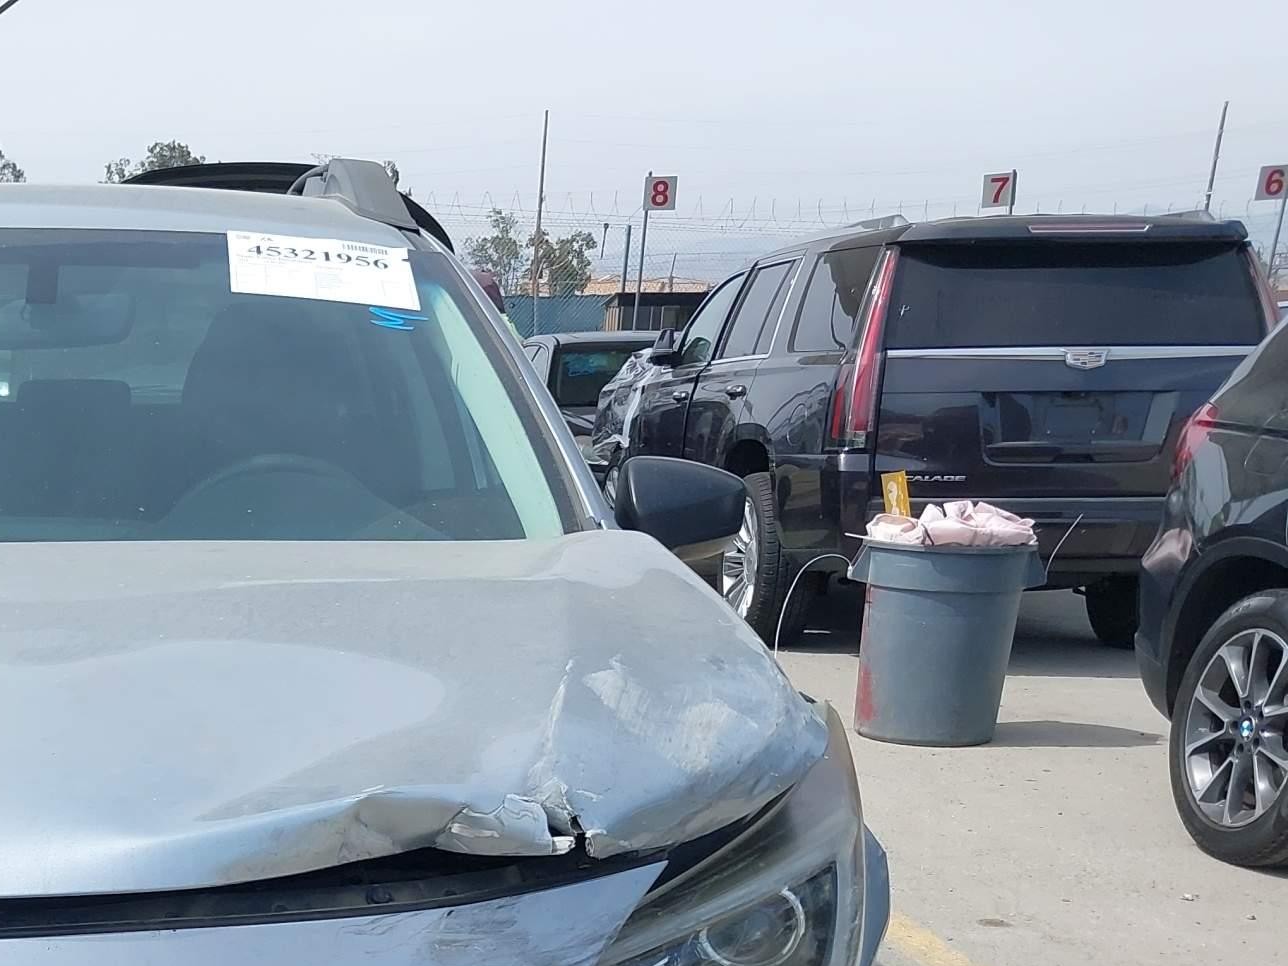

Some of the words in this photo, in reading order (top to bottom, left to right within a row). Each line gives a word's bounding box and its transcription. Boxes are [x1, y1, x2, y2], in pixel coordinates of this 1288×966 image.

[652, 180, 669, 207] 8
[991, 176, 1010, 203] 7
[1265, 169, 1285, 196] 6
[247, 245, 389, 270] 45321956
